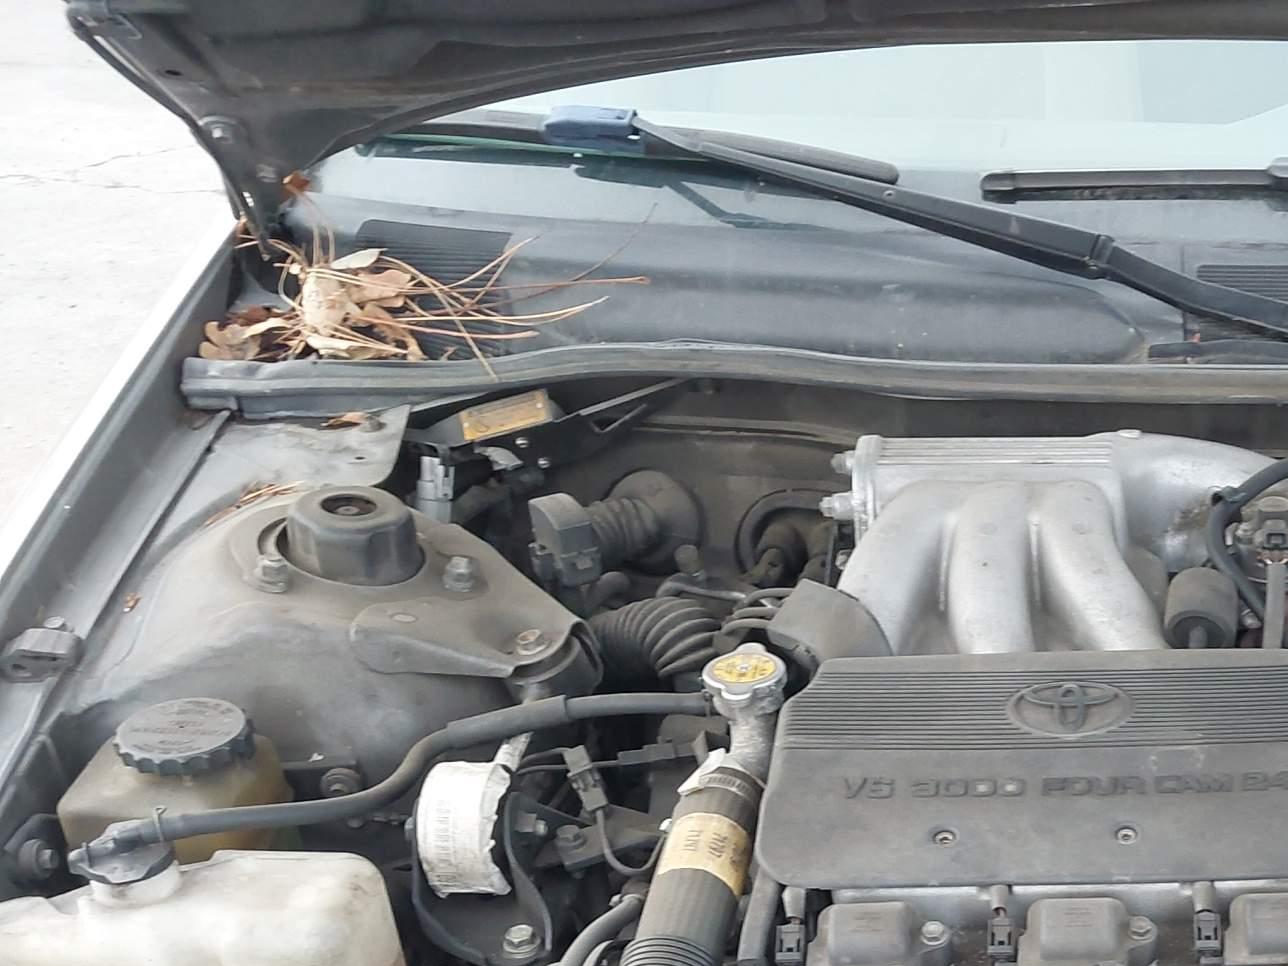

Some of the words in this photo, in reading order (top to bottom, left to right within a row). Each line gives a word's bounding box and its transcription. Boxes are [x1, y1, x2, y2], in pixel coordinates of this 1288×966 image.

[911, 776, 1026, 799] 3000
[1040, 774, 1148, 797] FOUR
[1152, 773, 1234, 795] CAM
